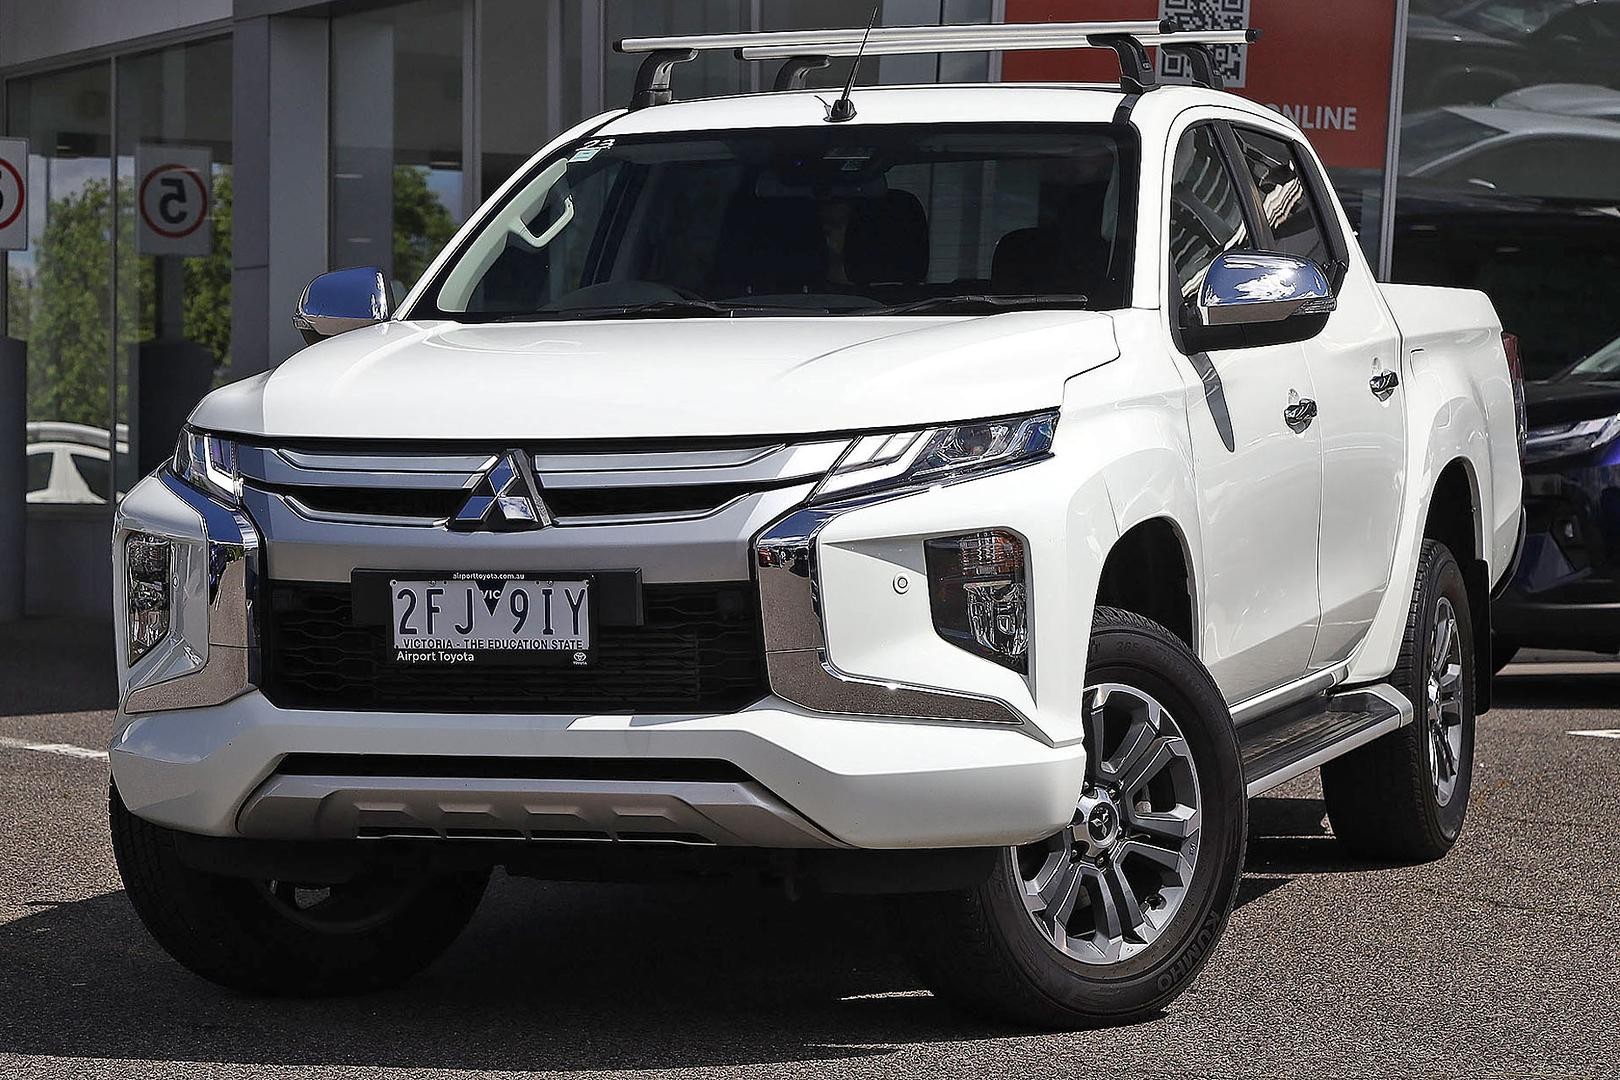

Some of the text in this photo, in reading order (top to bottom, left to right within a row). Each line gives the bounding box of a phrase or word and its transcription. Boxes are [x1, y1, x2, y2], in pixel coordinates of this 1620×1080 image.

[481, 590, 501, 599] VIC
[403, 639, 454, 649] VICTORIA
[464, 639, 486, 649] THE
[488, 640, 548, 649] EDUCATION
[551, 640, 583, 649] STATE
[397, 651, 474, 663] Airport Toyota
[1157, 910, 1220, 991] KUMHO
